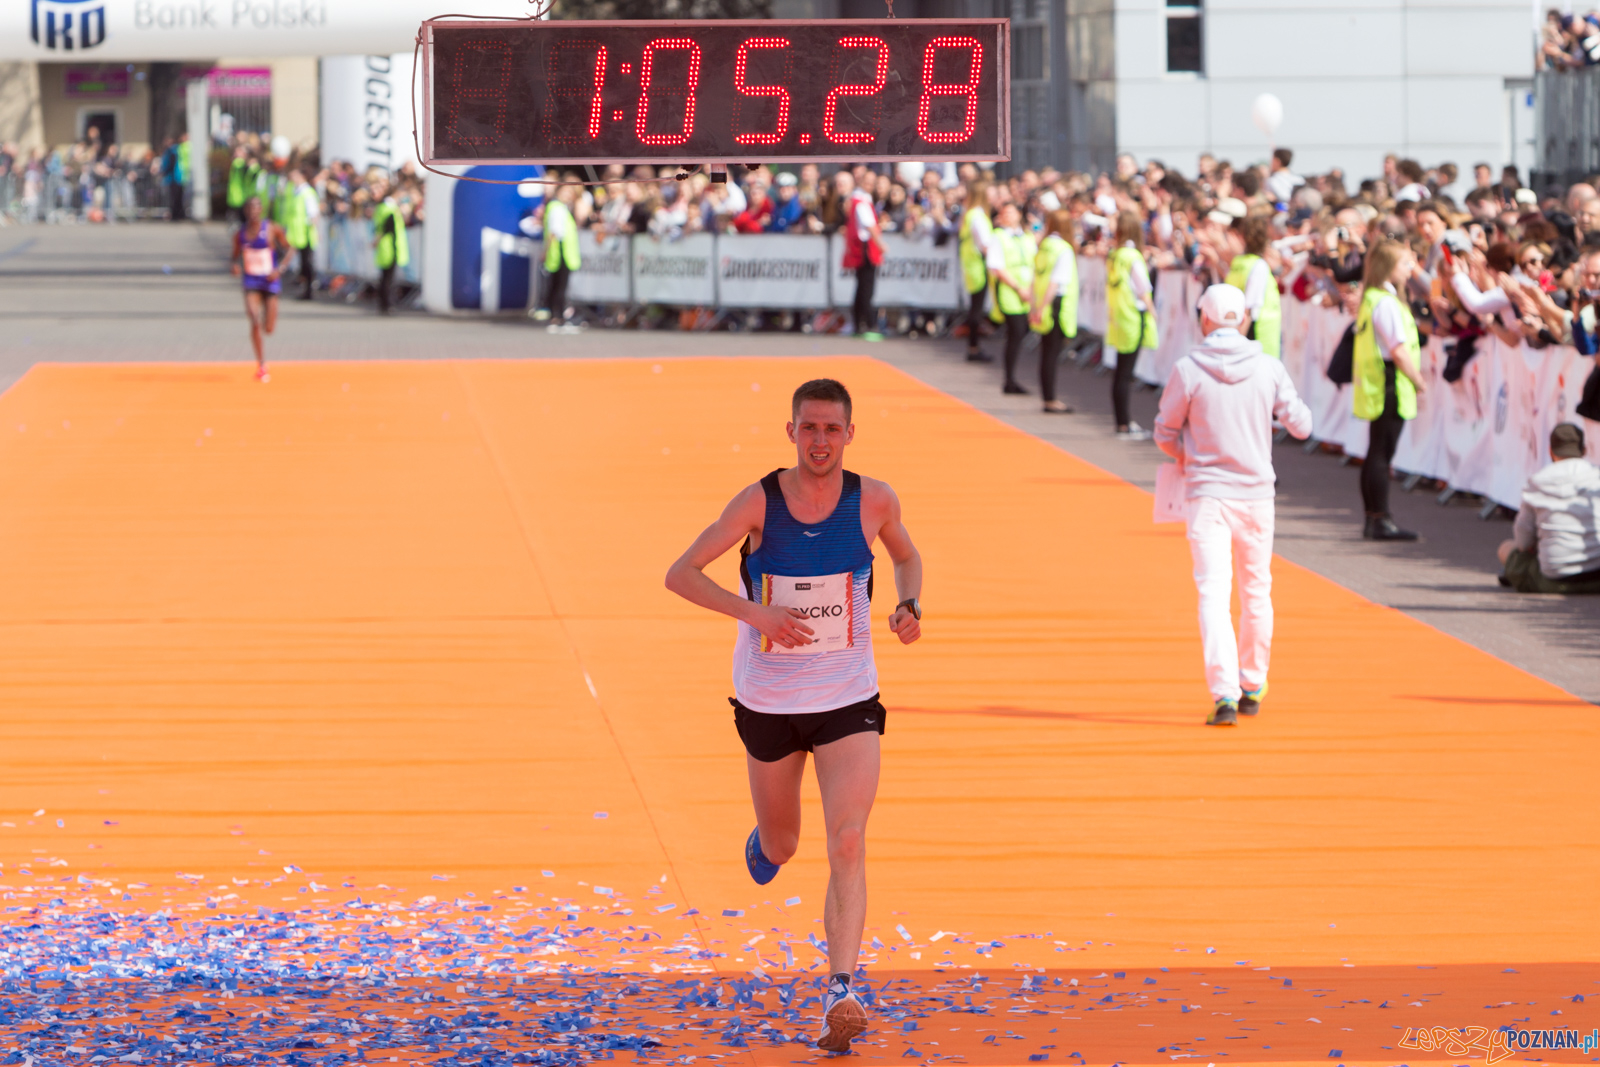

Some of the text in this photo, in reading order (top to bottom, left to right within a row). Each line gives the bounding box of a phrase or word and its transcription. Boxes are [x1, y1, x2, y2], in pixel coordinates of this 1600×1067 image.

[134, 0, 327, 29] Bank Polski
[791, 605, 843, 619] YCKO
